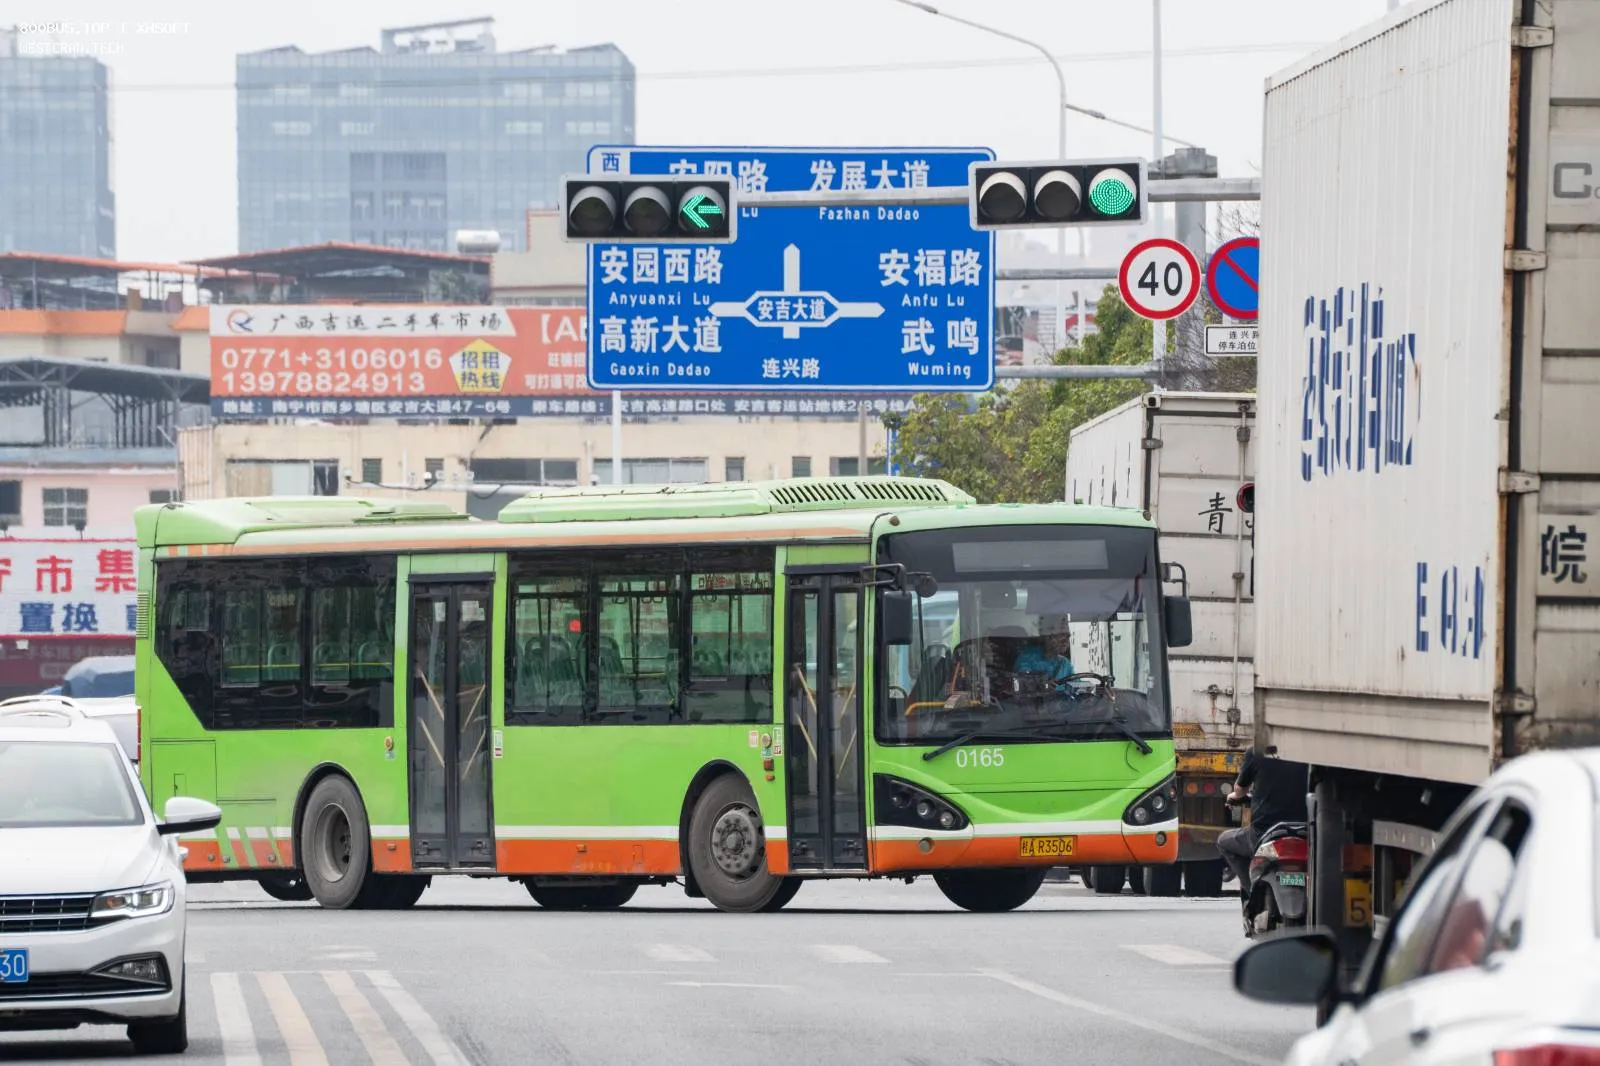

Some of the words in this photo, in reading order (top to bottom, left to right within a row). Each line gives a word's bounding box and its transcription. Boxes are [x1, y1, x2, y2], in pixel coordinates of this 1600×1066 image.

[601, 153, 621, 172] 西
[810, 160, 931, 192] 发展大道
[819, 207, 870, 221] Fazhan
[878, 207, 920, 221] Dadao
[600, 247, 724, 285] 安园西路
[878, 249, 982, 287] 安福路
[1137, 261, 1183, 297] 40
[609, 291, 682, 307] Anyuanxi
[693, 292, 711, 306] Lu
[757, 299, 826, 321] 安吉大道
[902, 293, 938, 307] Anfu
[947, 293, 965, 307] Lu
[599, 317, 723, 354] 高新大道
[902, 318, 979, 356] 武鸣
[221, 348, 443, 370] 0771+3106016
[461, 350, 500, 369] 招租
[610, 362, 660, 377] Gaoxin
[667, 362, 711, 377] Dadao
[762, 358, 821, 380] 连兴路
[461, 371, 500, 389] 热线
[908, 362, 972, 379] Wuming
[221, 371, 425, 393] 13978824913
[956, 748, 1005, 768] 0165
